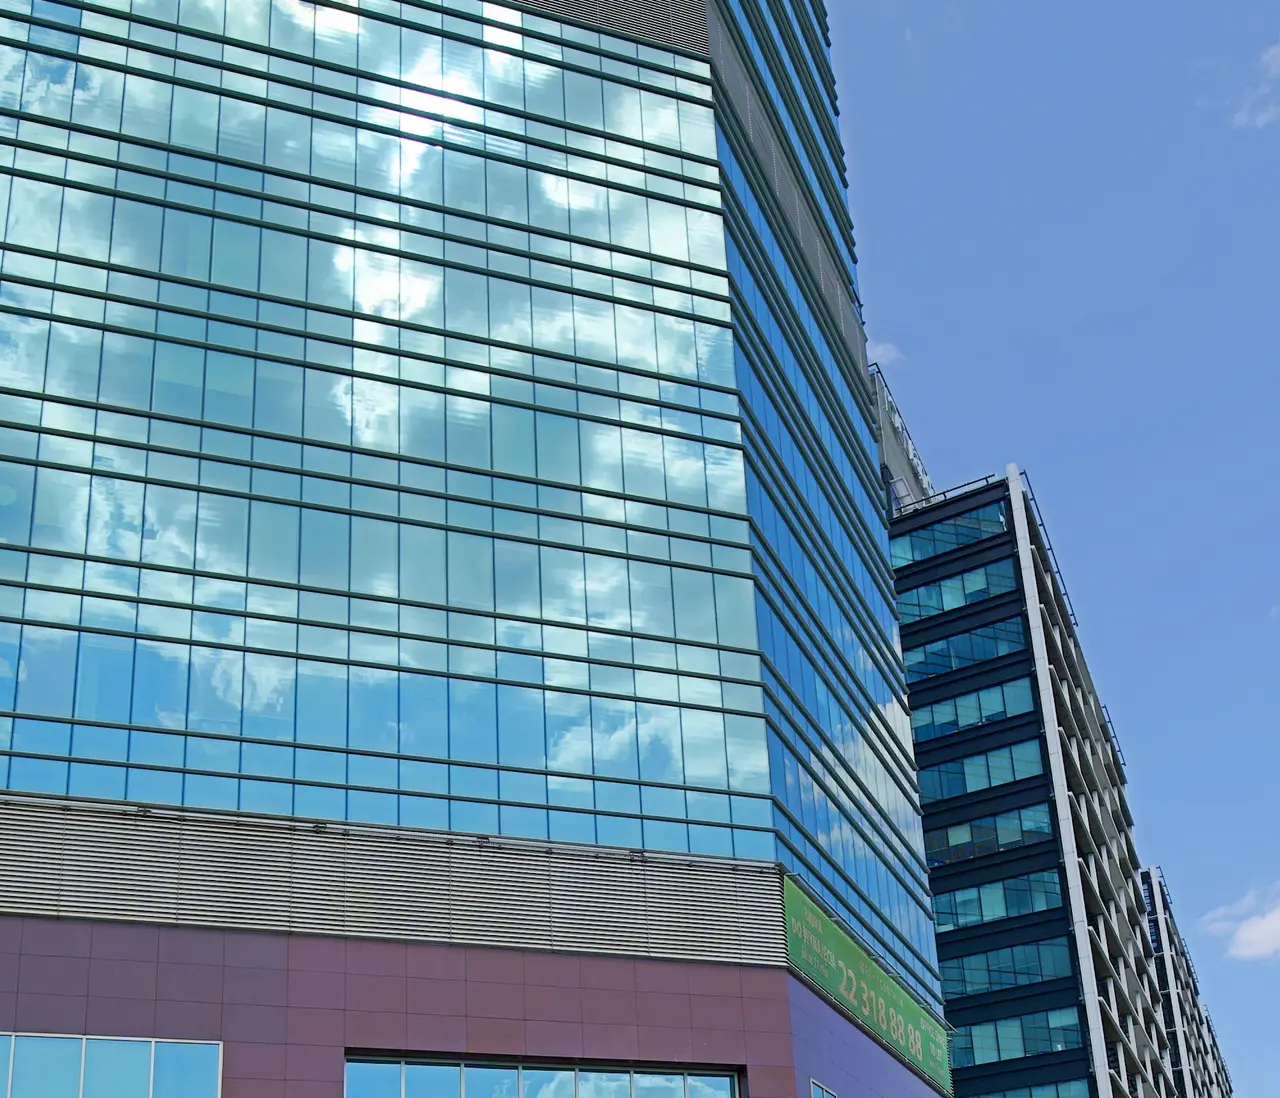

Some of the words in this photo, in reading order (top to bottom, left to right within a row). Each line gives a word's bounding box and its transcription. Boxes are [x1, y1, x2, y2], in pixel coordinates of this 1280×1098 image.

[838, 960, 858, 1006] 22
[860, 980, 887, 1031] 318
[889, 1007, 906, 1047] 88
[907, 1023, 923, 1061] 88
